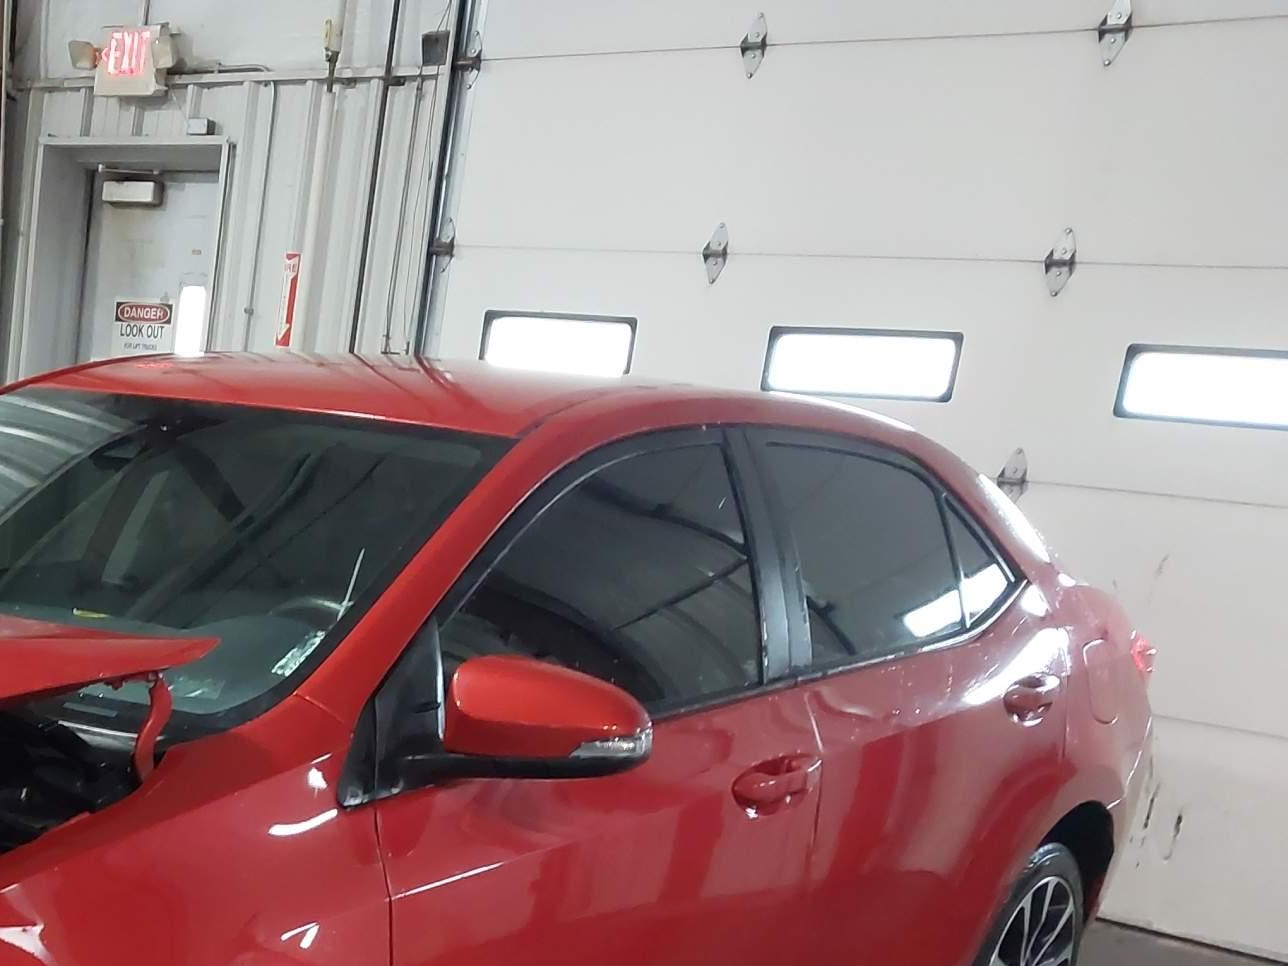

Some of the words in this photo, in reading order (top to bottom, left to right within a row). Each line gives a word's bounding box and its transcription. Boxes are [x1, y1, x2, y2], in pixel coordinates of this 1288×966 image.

[107, 31, 150, 75] EXIT
[123, 306, 164, 320] DANGER
[120, 323, 144, 338] LOOK
[146, 325, 165, 339] OUT
